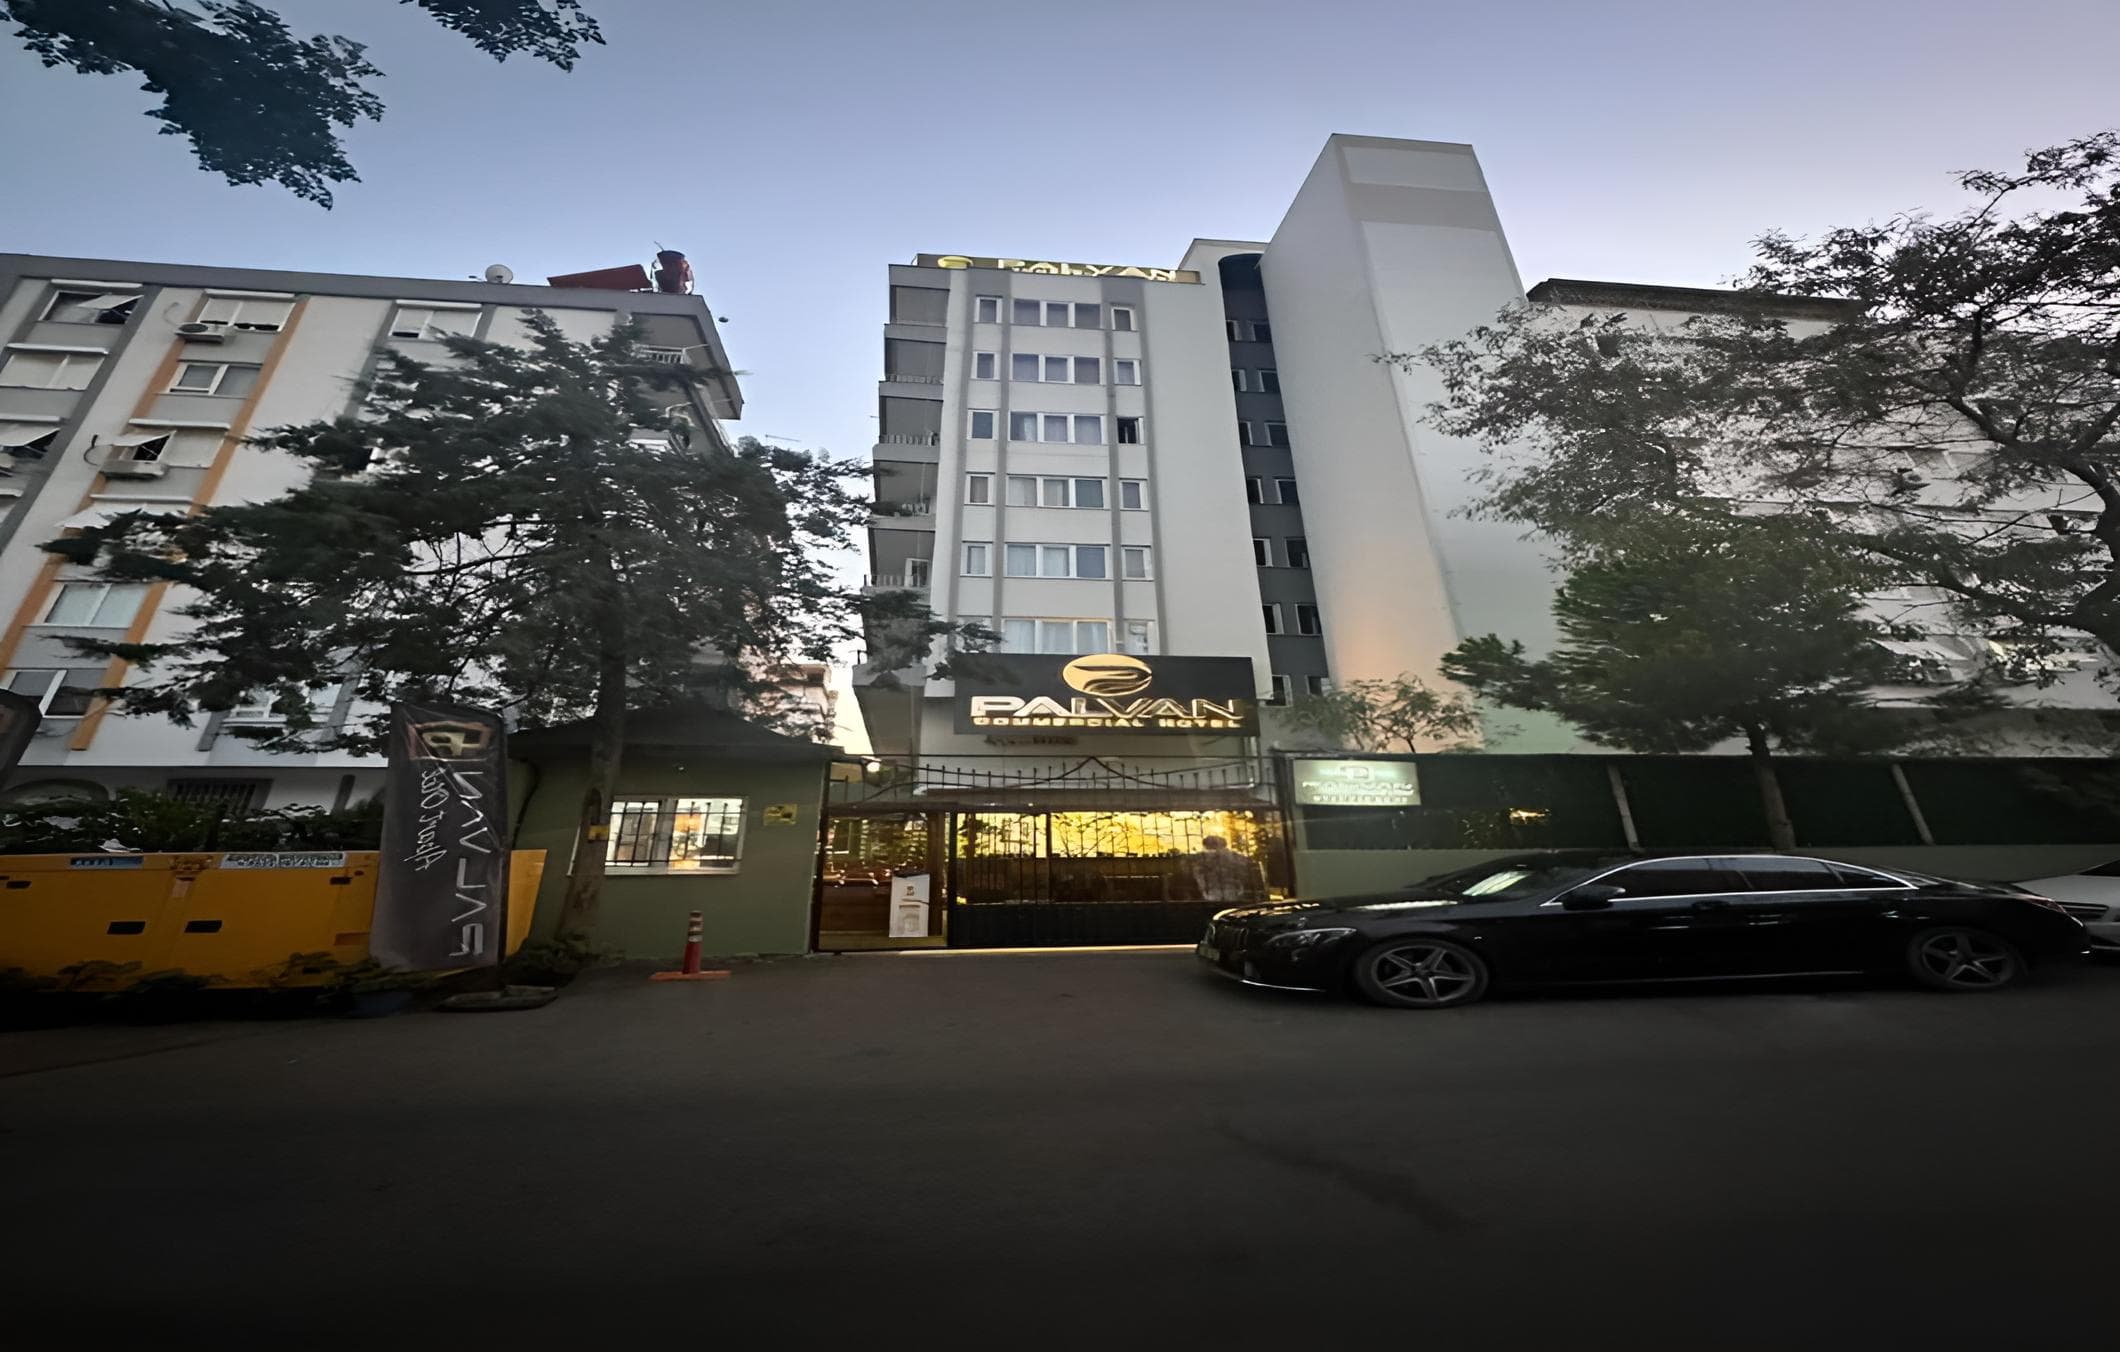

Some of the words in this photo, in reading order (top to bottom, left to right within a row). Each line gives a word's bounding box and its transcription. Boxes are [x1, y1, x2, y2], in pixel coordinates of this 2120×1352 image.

[970, 696, 1244, 719] PALVAN
[973, 717, 1144, 727] COMMERCIAL
[1158, 719, 1240, 728] HOTEL
